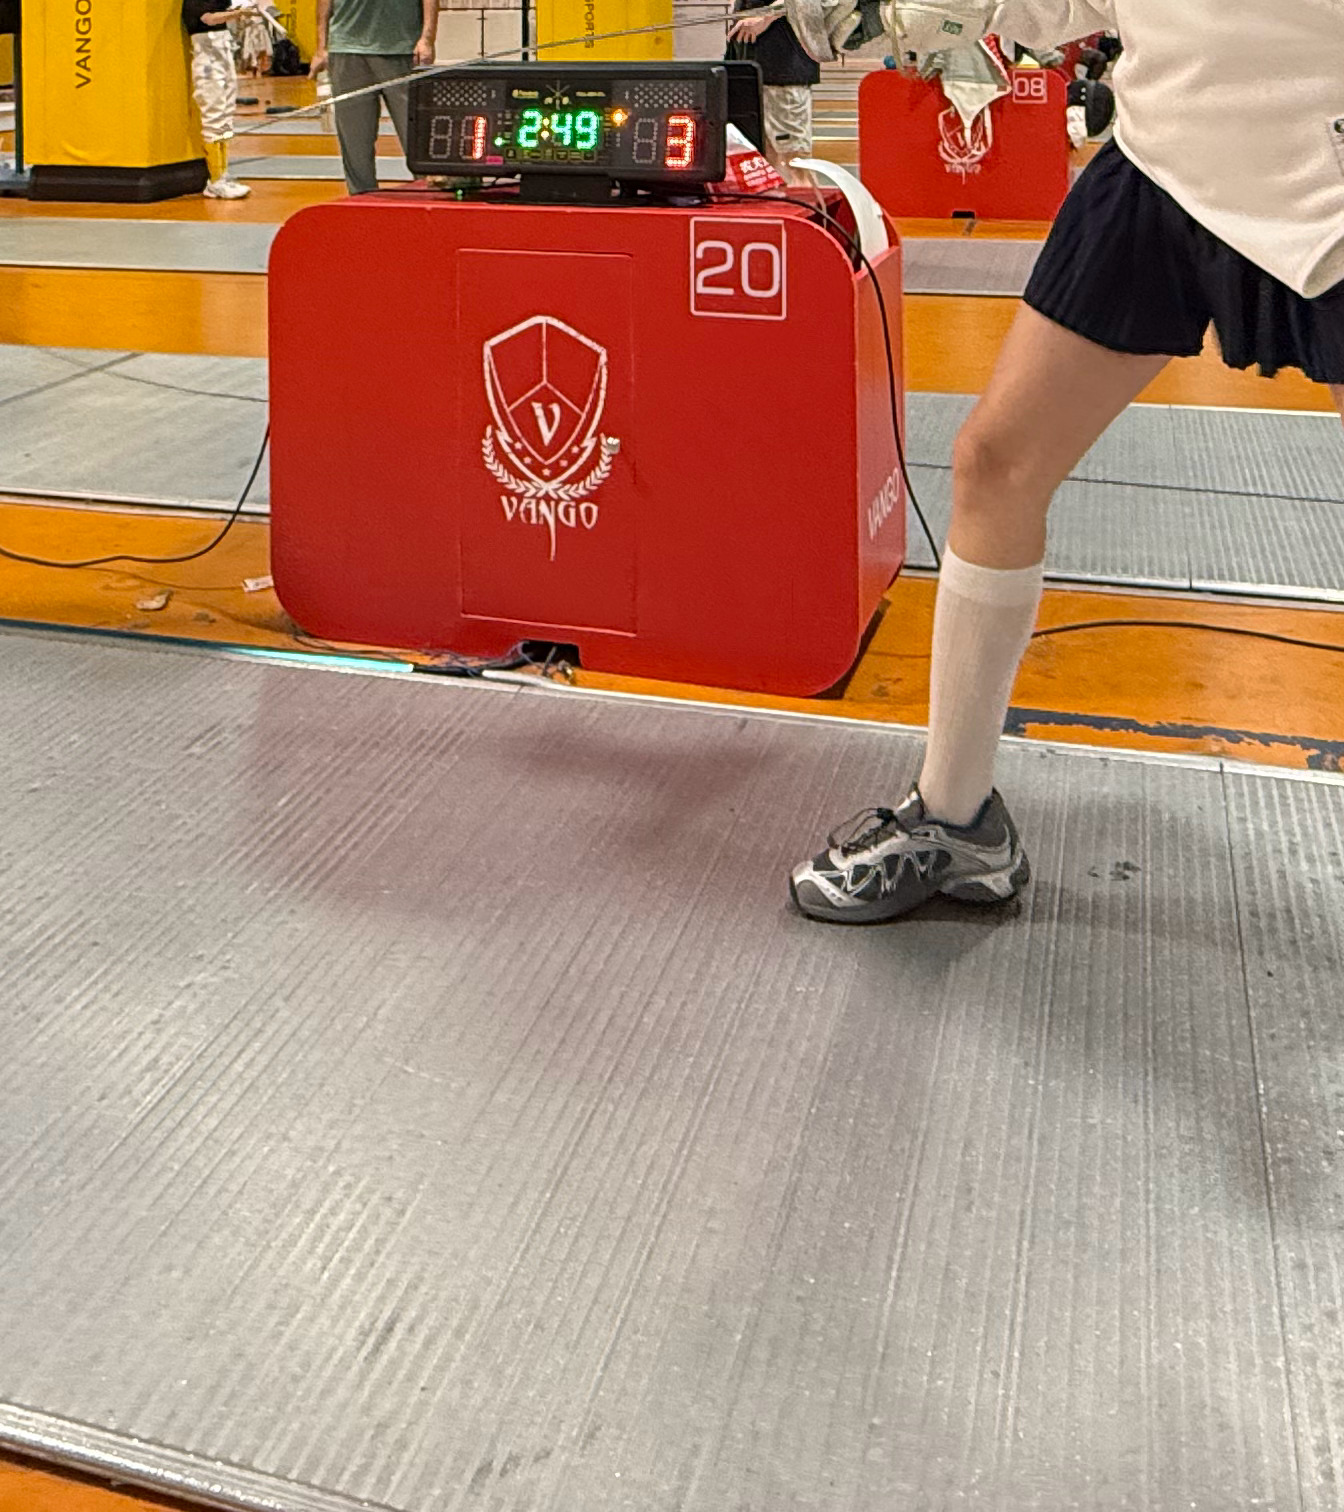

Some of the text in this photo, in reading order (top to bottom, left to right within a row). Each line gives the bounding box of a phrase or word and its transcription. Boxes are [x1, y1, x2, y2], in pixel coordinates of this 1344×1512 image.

[1014, 77, 1044, 97] 08
[471, 115, 487, 160] 1
[517, 109, 601, 150] 2:49
[665, 113, 696, 169] 3
[696, 240, 781, 298] 20
[531, 401, 562, 447] V
[500, 495, 599, 561] VANGO
[867, 467, 900, 541] VANGO
